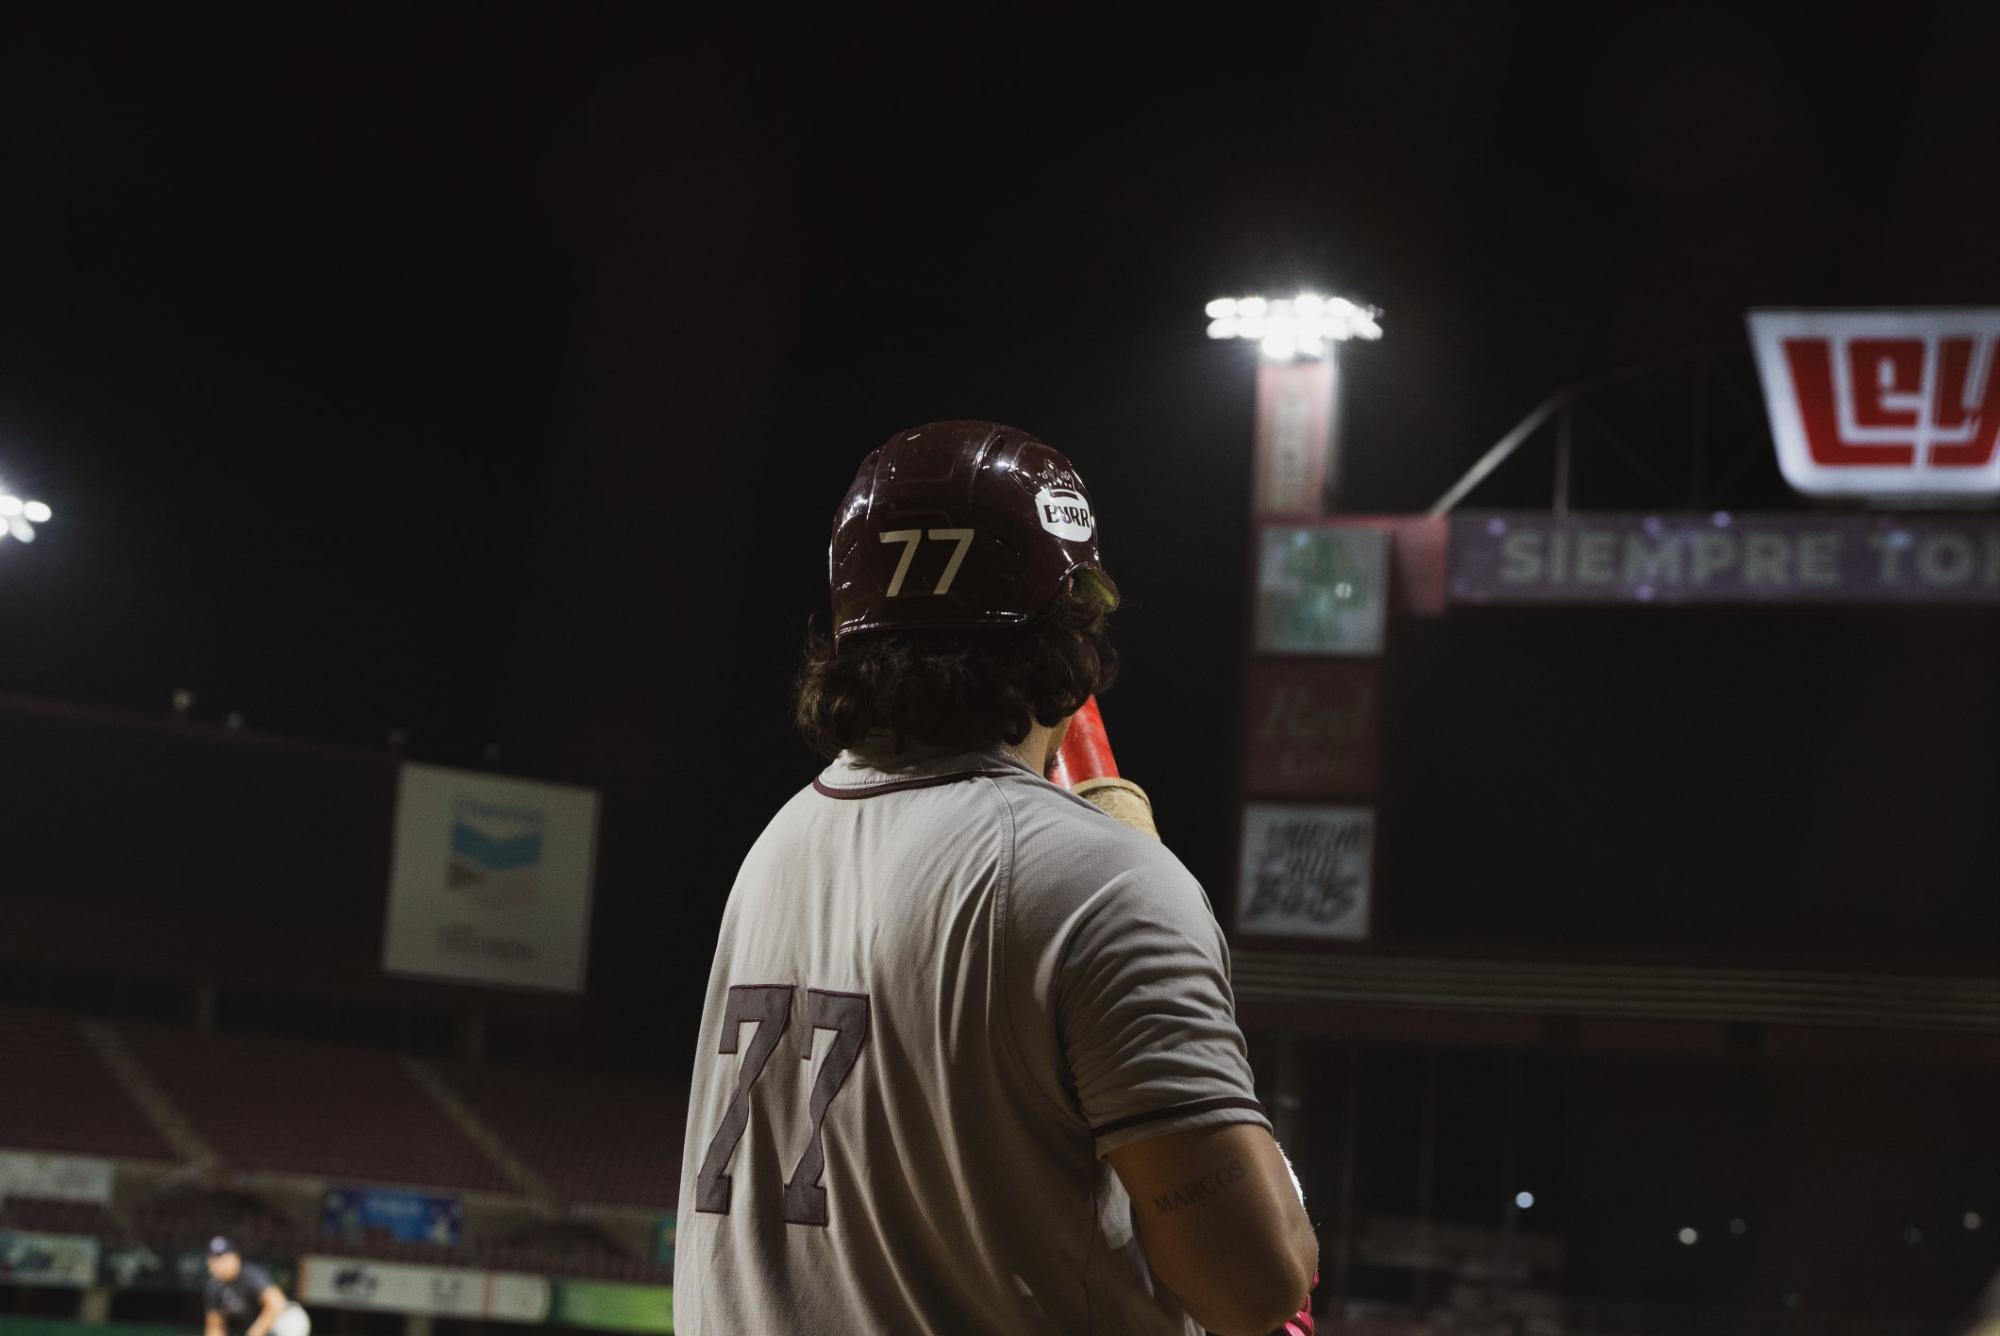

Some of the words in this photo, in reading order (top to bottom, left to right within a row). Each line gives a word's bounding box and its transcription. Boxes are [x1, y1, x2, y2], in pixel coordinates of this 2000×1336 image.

[879, 528, 975, 598] 77
[1501, 532, 1842, 585] SIEMPRE
[696, 984, 869, 1226] 77
[1152, 1159, 1246, 1213] MARCOS
